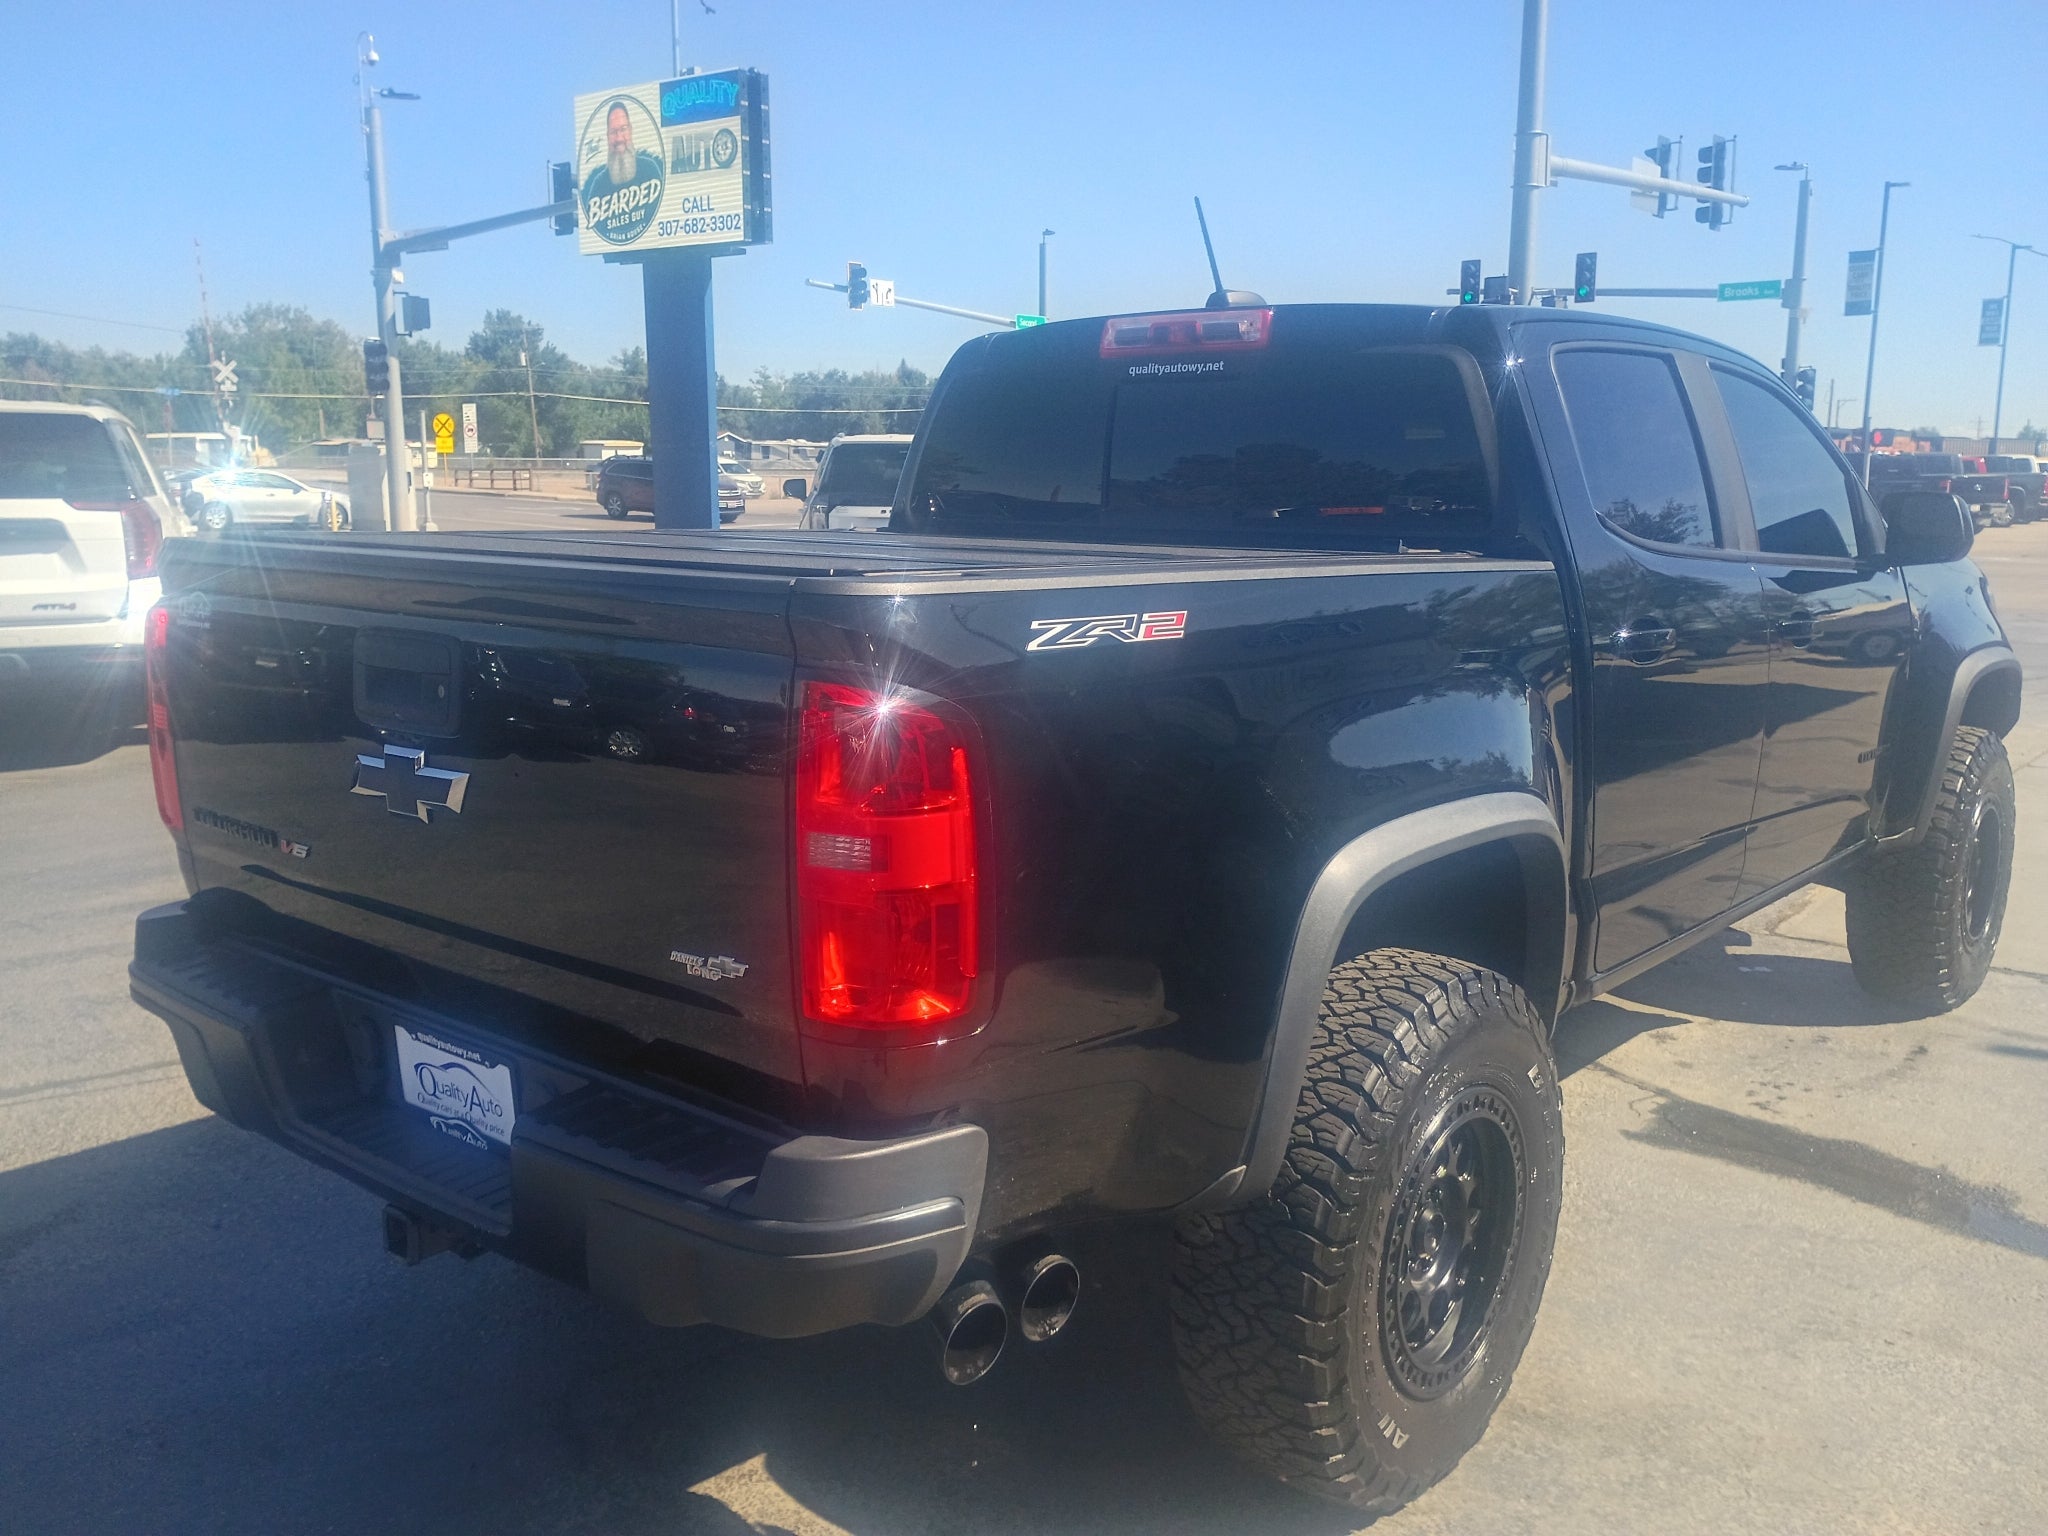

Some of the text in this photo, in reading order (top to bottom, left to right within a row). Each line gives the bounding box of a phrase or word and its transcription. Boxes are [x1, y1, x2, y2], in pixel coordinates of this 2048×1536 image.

[662, 80, 738, 116] QUALITY
[587, 178, 661, 230] BEARDED
[682, 196, 715, 213] CALL
[607, 209, 645, 229] SALES GUY
[657, 214, 742, 237] 307-682-3302
[1724, 287, 1760, 297] Brooks
[1128, 360, 1225, 377] qualityautowy.net
[1026, 610, 1188, 651] ZR2
[281, 839, 311, 859] V6
[670, 951, 704, 966] DANIELS
[687, 964, 721, 980] LONG
[489, 1122, 505, 1137] price
